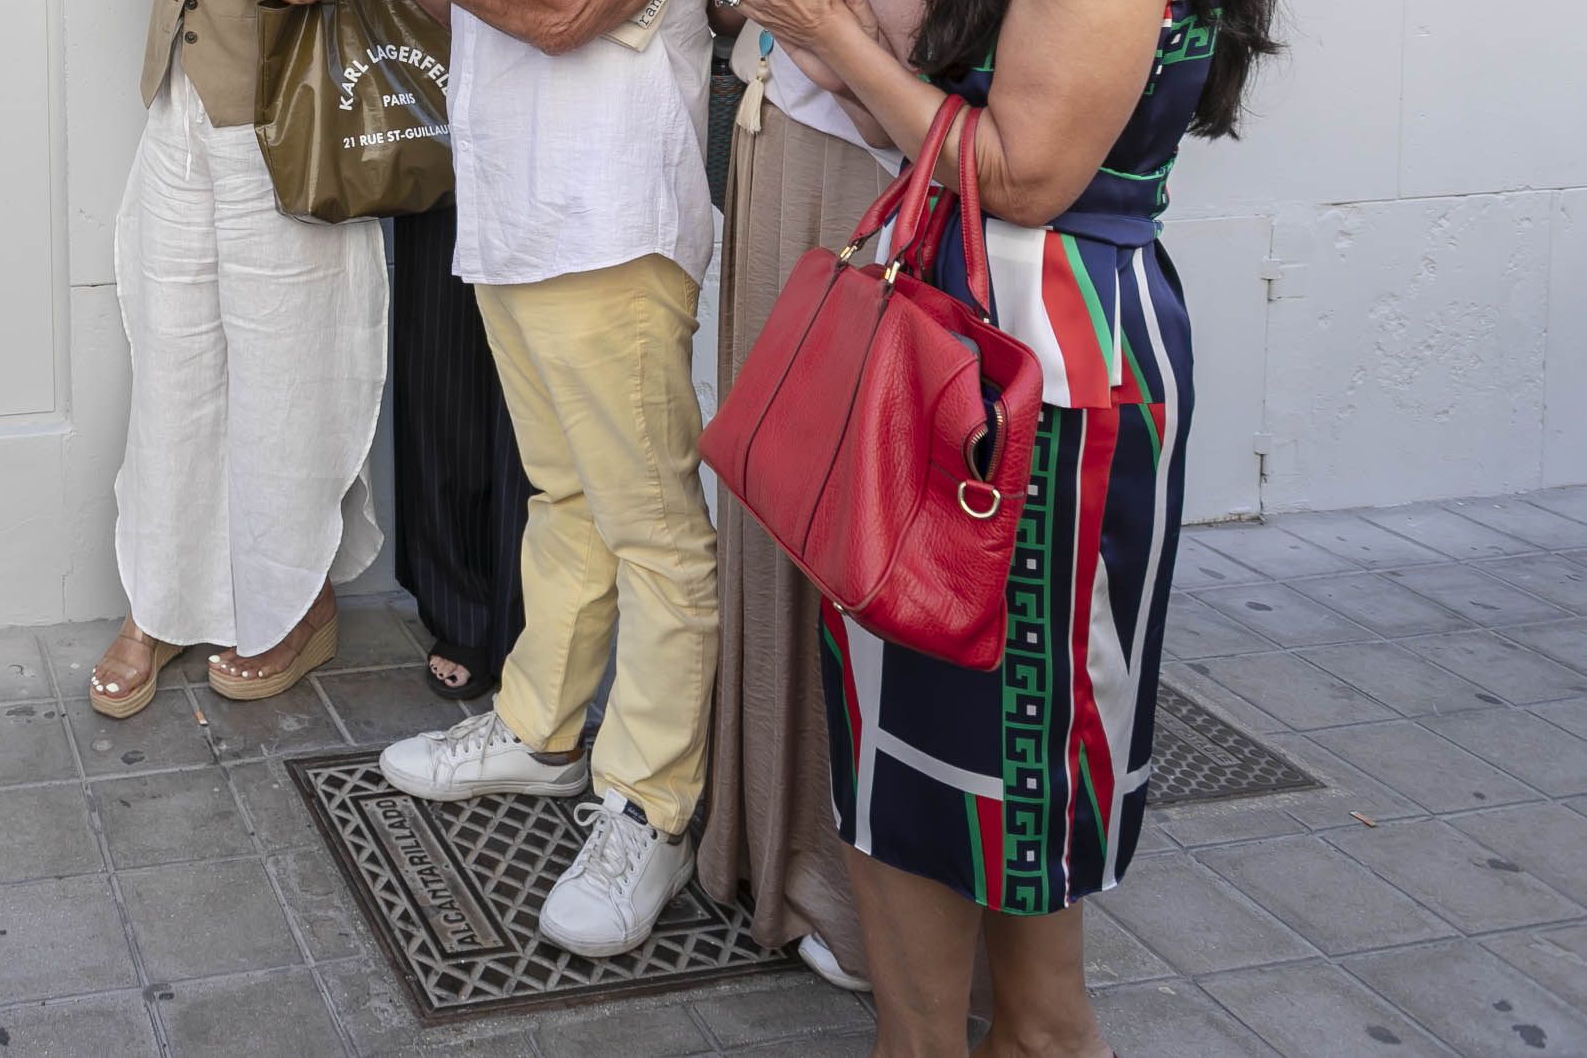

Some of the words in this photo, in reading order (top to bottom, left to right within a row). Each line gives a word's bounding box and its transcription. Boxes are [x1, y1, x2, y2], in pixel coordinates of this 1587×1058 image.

[339, 59, 369, 111] KARL
[382, 93, 416, 108] PARIS
[343, 137, 355, 149] 21
[359, 132, 384, 147] RUE
[387, 124, 451, 142] ST-GUILLAU
[375, 799, 478, 946] ALCANTARILLADO
